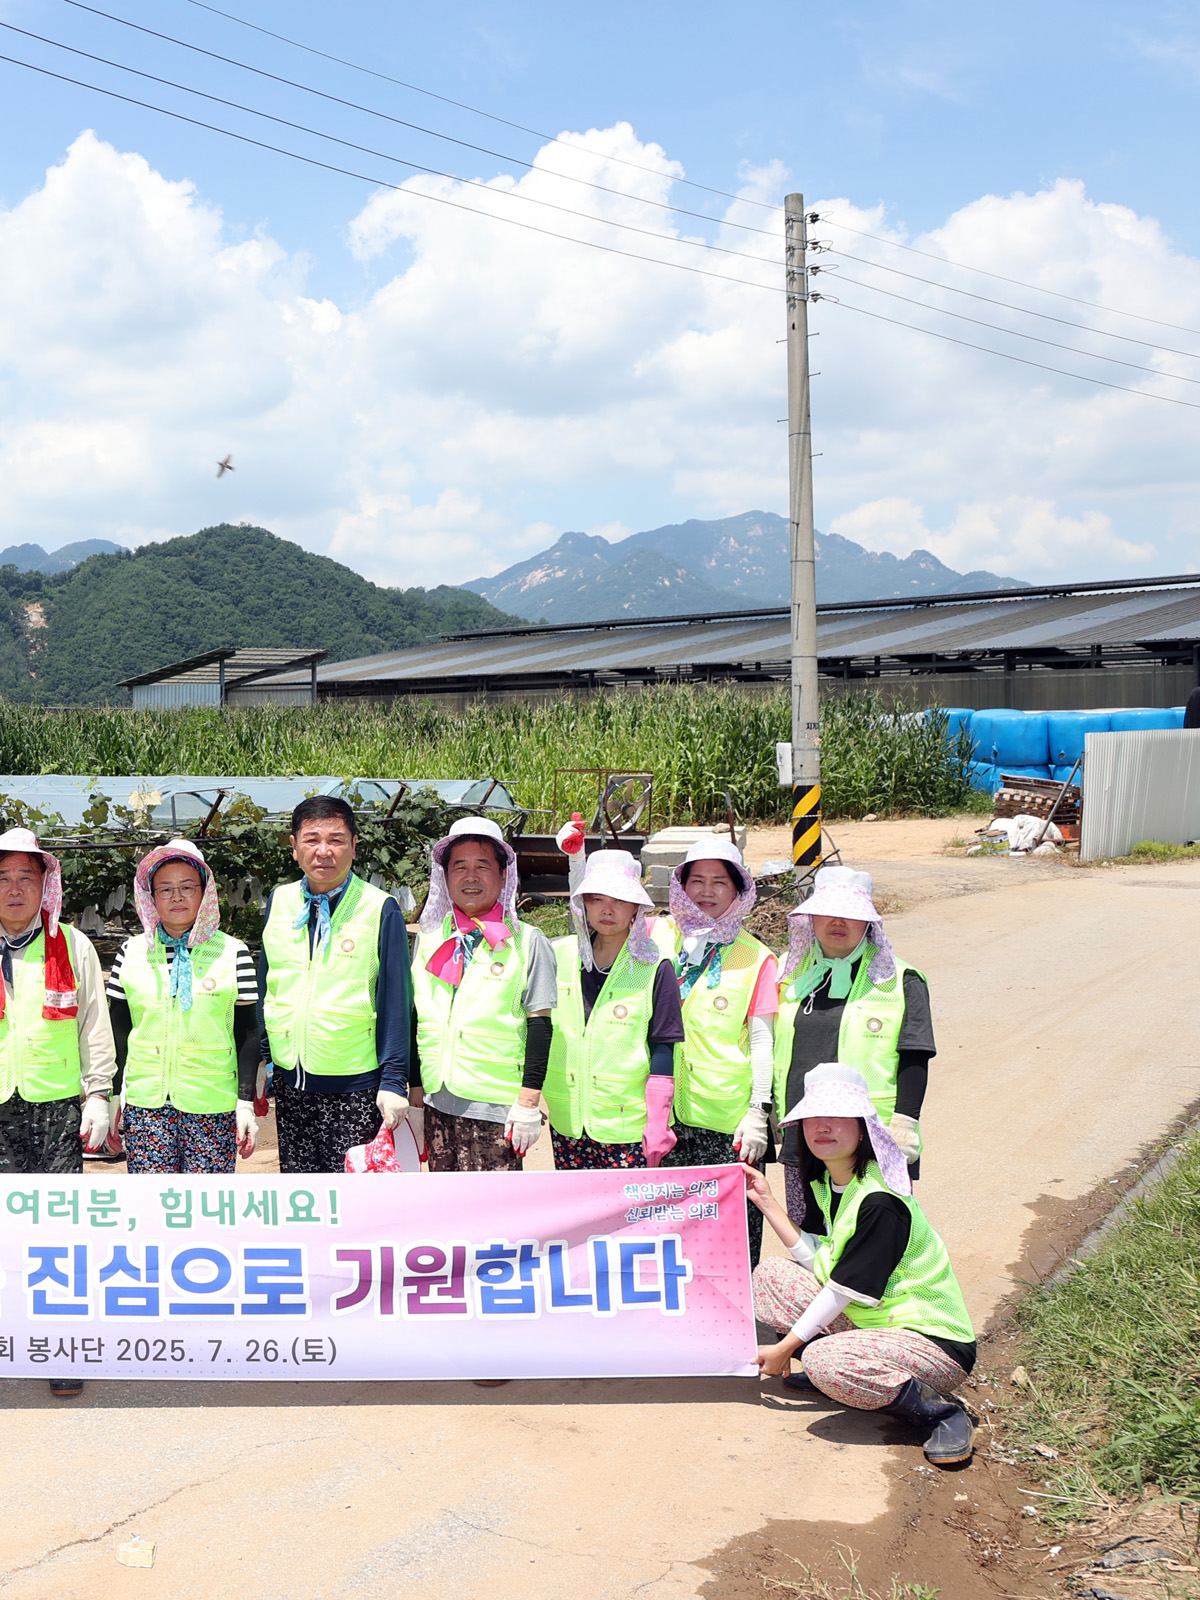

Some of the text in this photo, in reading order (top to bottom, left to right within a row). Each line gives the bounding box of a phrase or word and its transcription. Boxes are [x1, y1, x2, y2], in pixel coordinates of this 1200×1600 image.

[625, 1180, 717, 1200] 책임지는 의정
[6, 1189, 137, 1231] 여러분,
[161, 1188, 339, 1228] 힘내세요!
[626, 1203, 717, 1221] 신뢰받는 의회
[27, 1244, 307, 1317] 진심으로
[335, 1239, 687, 1315] 기원합니다
[27, 1335, 105, 1363] 봉사단
[116, 1338, 194, 1363] 2025.
[207, 1339, 232, 1363] 7.
